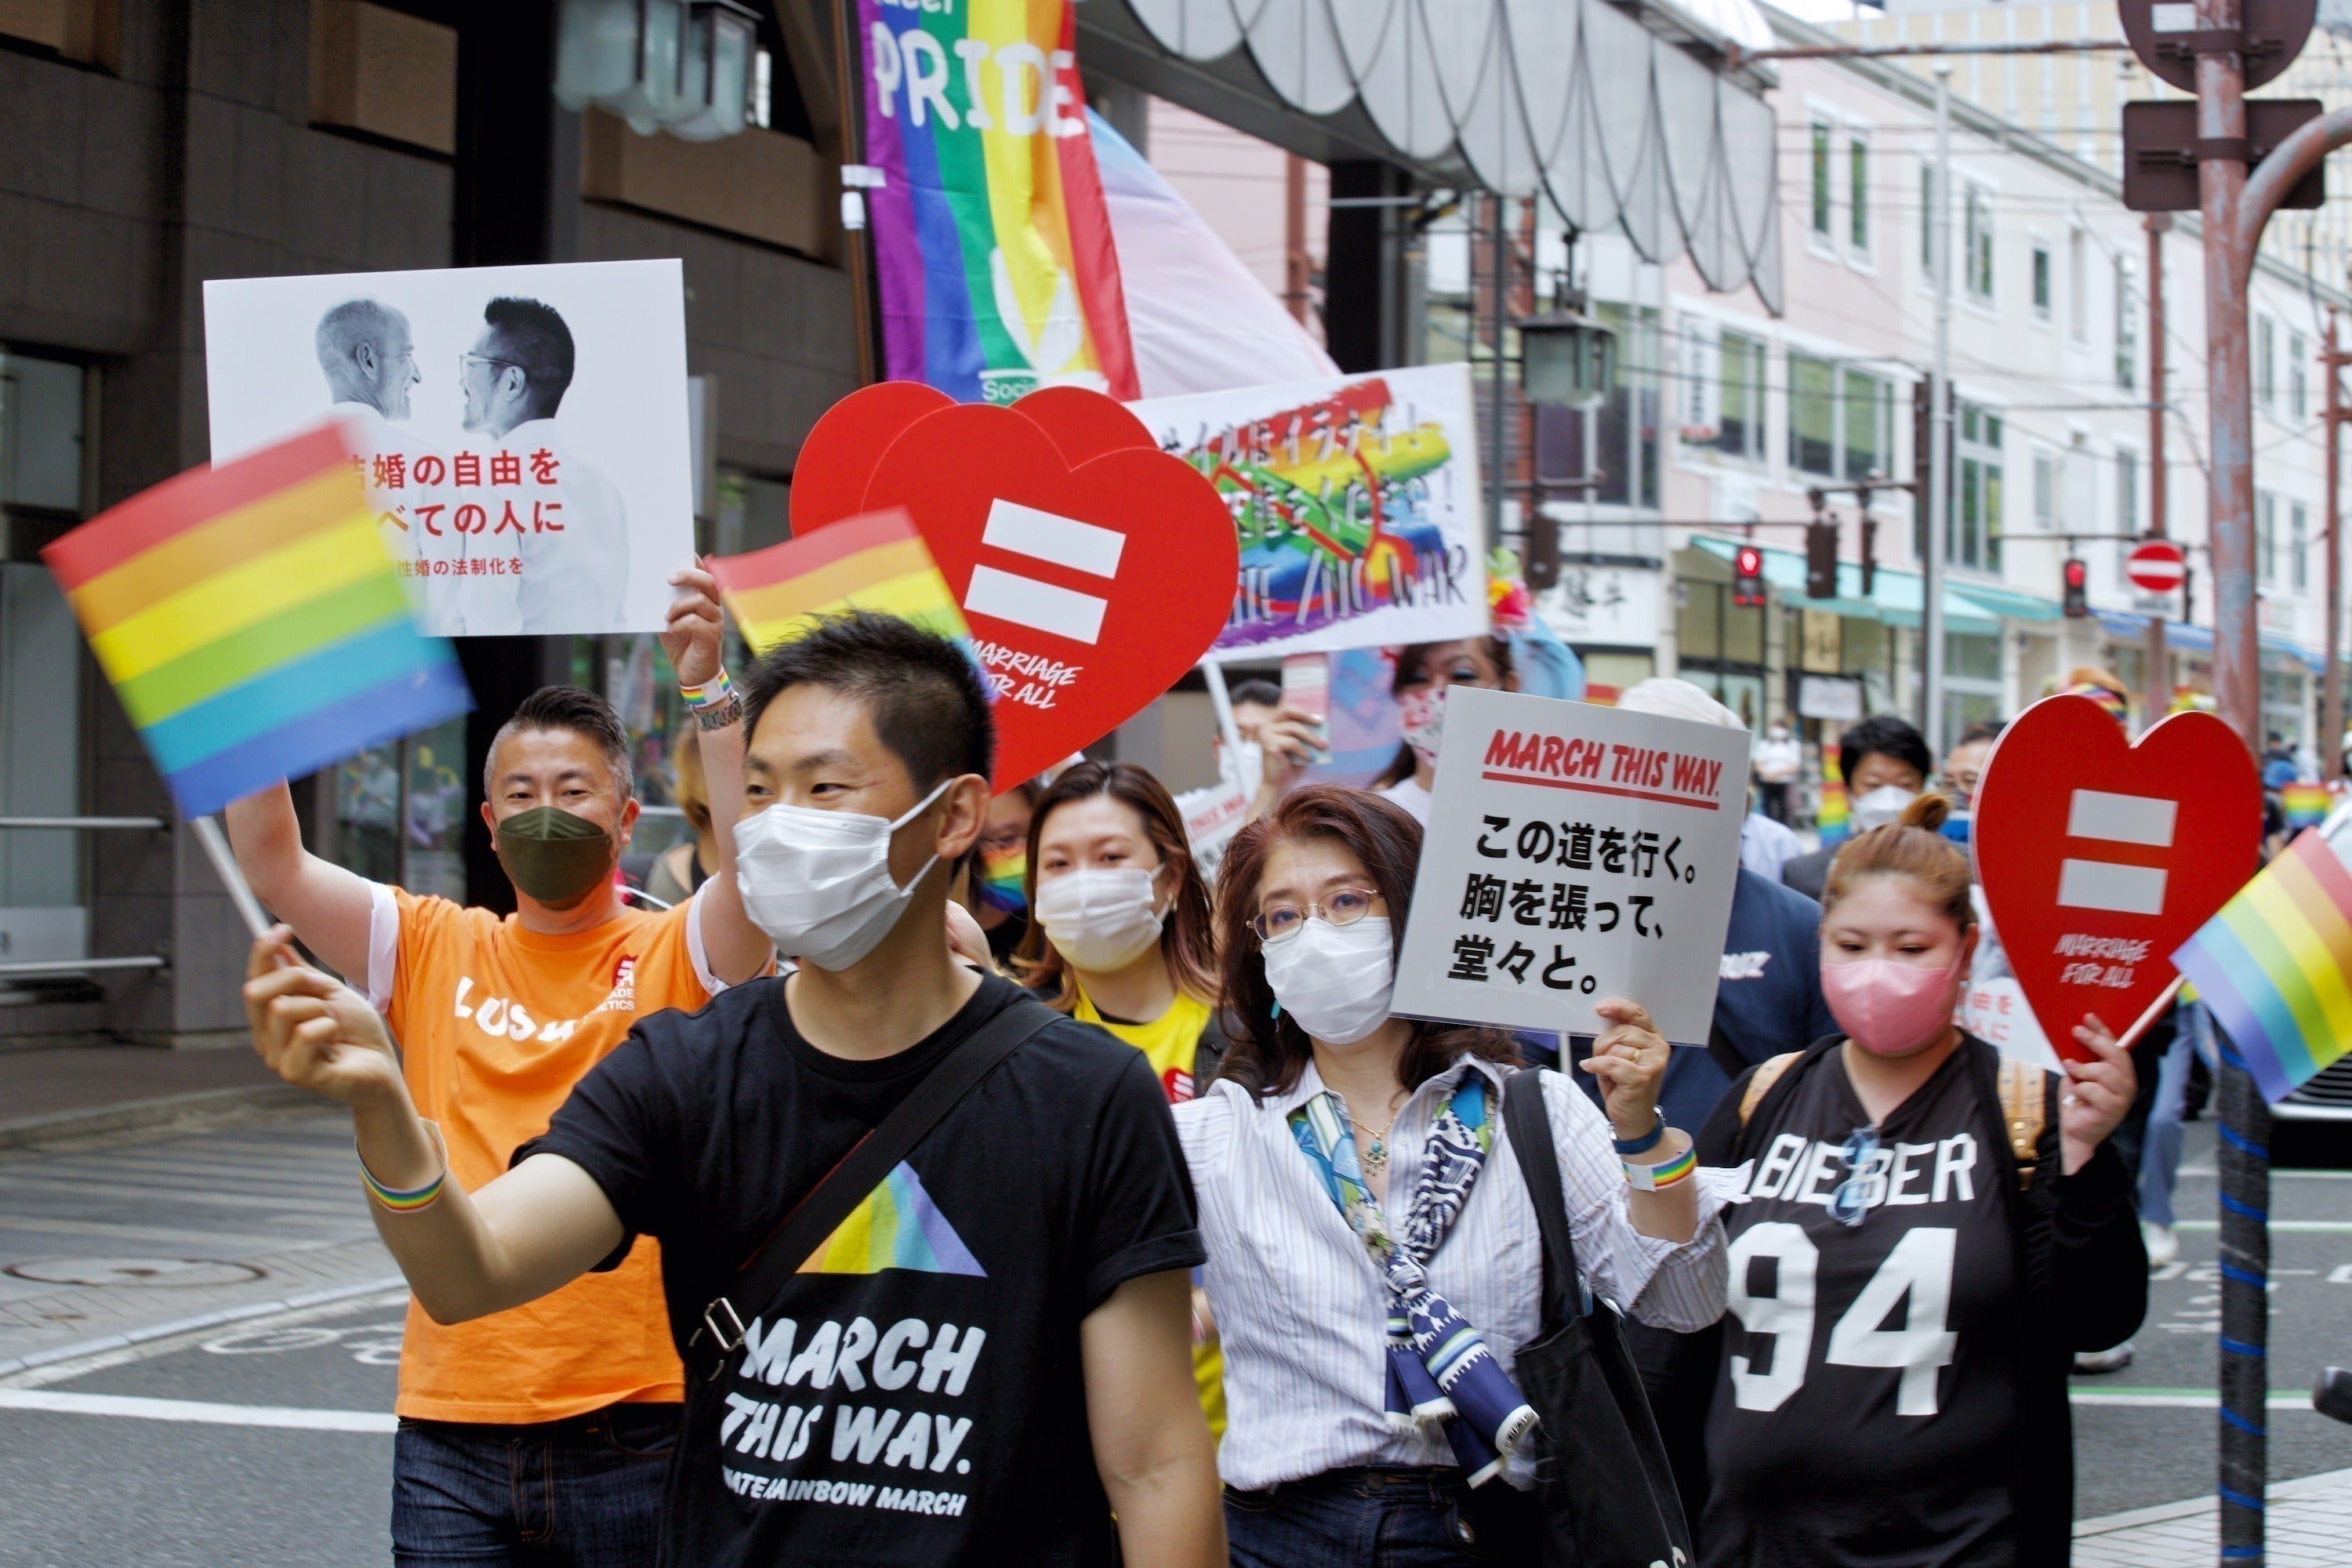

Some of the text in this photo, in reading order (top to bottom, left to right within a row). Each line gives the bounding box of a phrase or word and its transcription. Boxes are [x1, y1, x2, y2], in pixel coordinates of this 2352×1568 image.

[871, 21, 1086, 138] PRIDE
[376, 500, 564, 536] べての人に
[397, 557, 524, 578] 性婚の法制化を
[965, 638, 1083, 688] MARRIAGE
[981, 670, 1057, 710] OR ALL
[1483, 728, 1723, 798] MARCH THIS WAY.
[1477, 815, 1695, 884] この道を行く。
[1459, 873, 1664, 939] 胸を張って、
[1447, 935, 1596, 994] 堂々と。
[2100, 965, 2136, 989] ALL
[1748, 1133, 1977, 1208] BIEBER
[1726, 1221, 1959, 1416] 94
[739, 1316, 986, 1396] MARCH
[720, 1392, 973, 1475] THIS WAY.
[876, 1486, 967, 1517] MARCH
